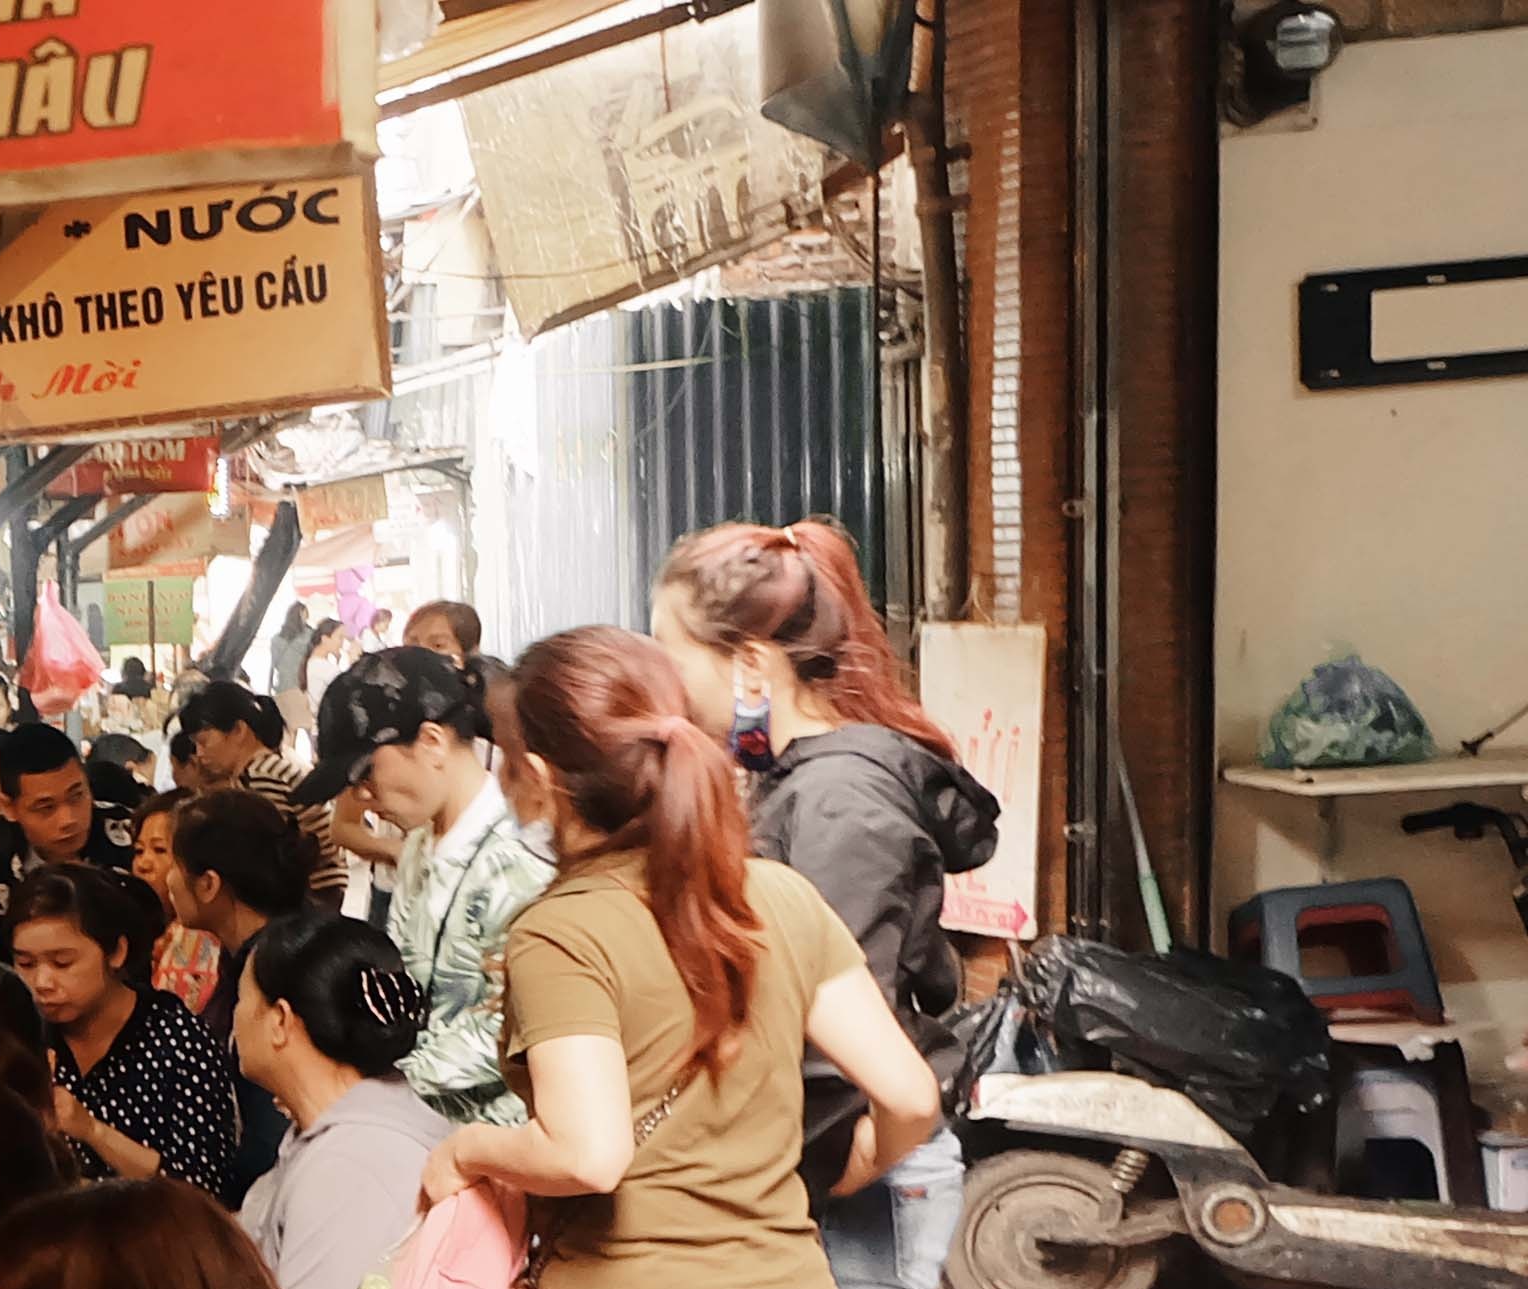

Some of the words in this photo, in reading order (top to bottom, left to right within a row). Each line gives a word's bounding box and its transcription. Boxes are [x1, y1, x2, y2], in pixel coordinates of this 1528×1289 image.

[75, 287, 163, 333] THEO
[176, 271, 244, 321] YÊU
[31, 359, 142, 399] Mời
